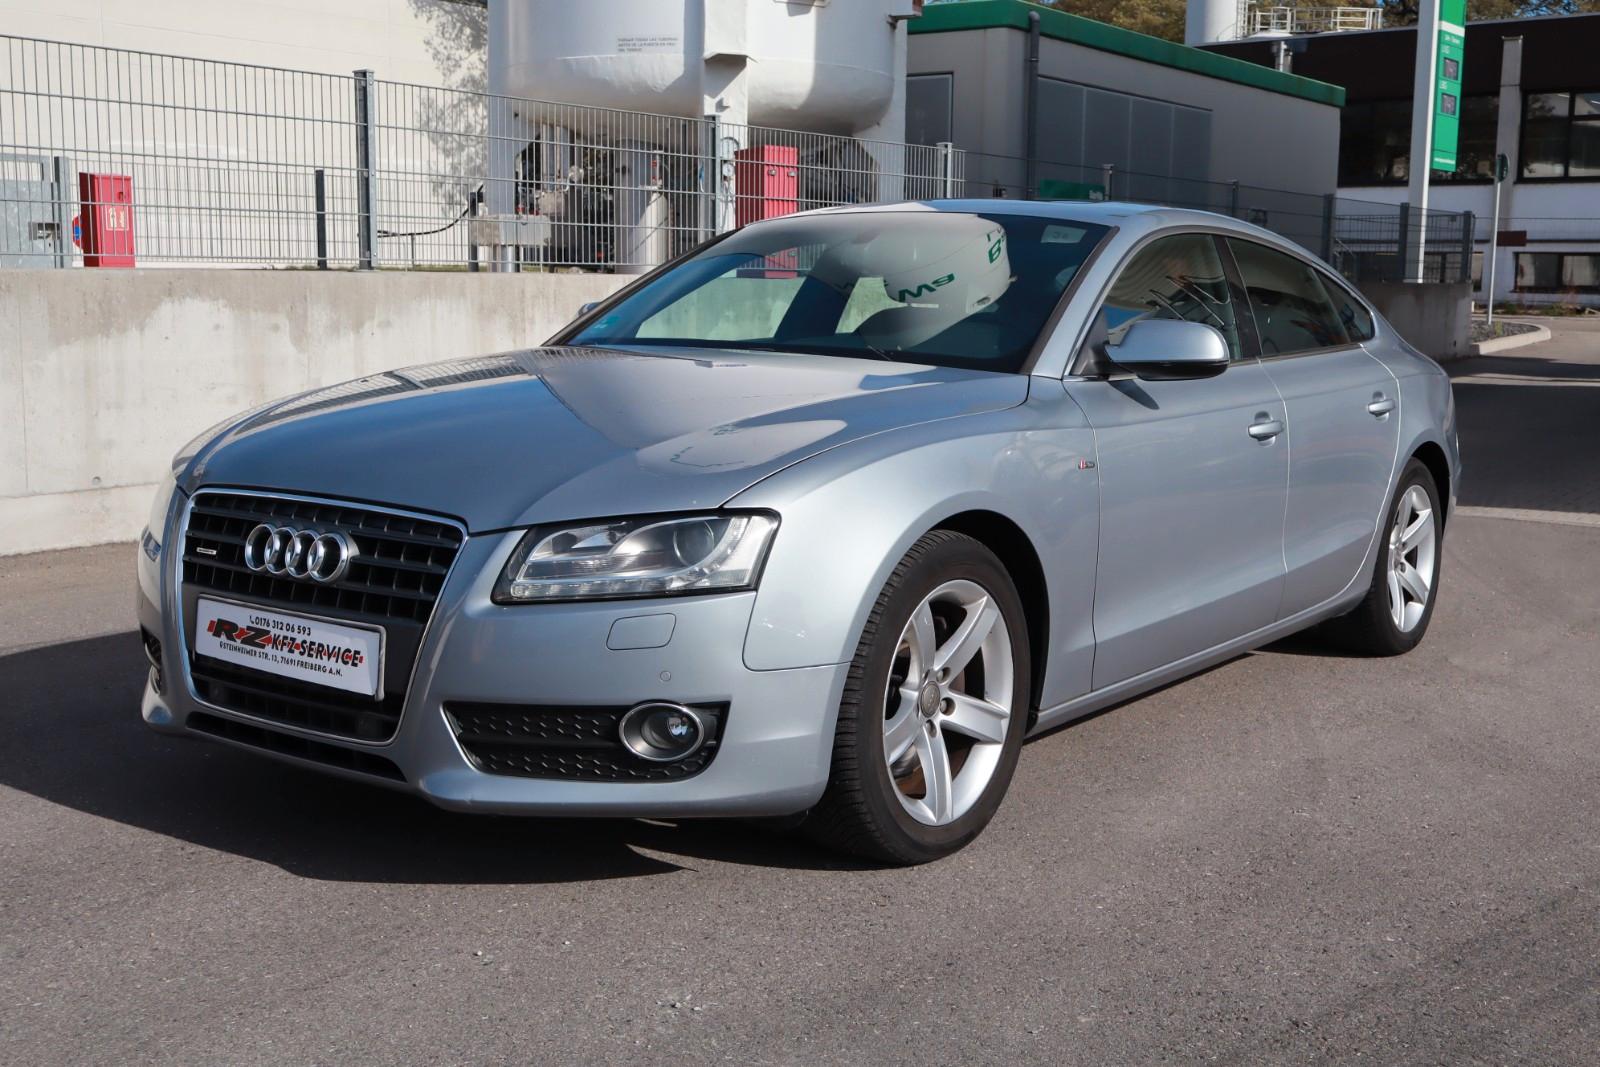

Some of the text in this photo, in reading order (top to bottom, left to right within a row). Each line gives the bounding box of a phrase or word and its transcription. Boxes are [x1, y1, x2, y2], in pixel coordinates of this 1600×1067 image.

[255, 617, 311, 636] 0176 312 06 593
[297, 660, 327, 673] FREIBERG
